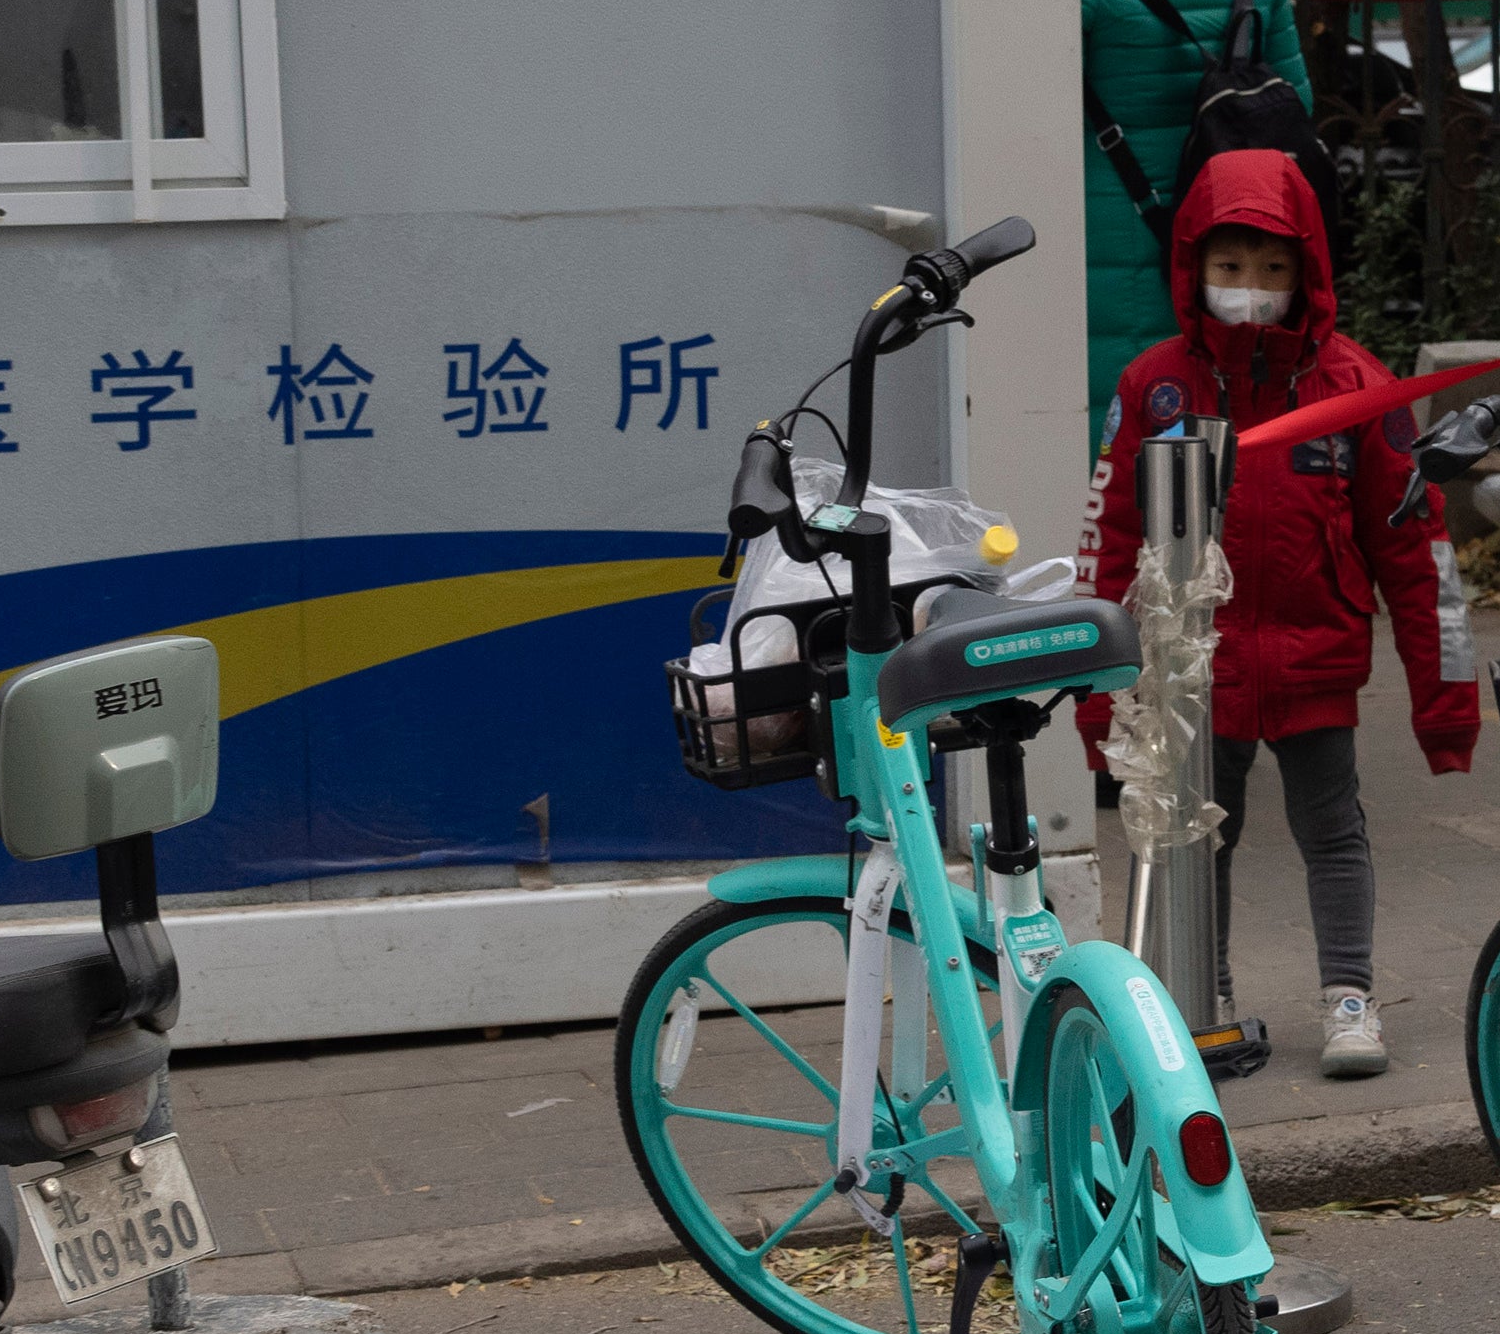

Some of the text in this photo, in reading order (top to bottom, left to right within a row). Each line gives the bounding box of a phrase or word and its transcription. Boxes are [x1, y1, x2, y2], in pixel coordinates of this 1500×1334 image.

[1050, 628, 1089, 646] 免押金
[95, 677, 164, 720] 爱玛
